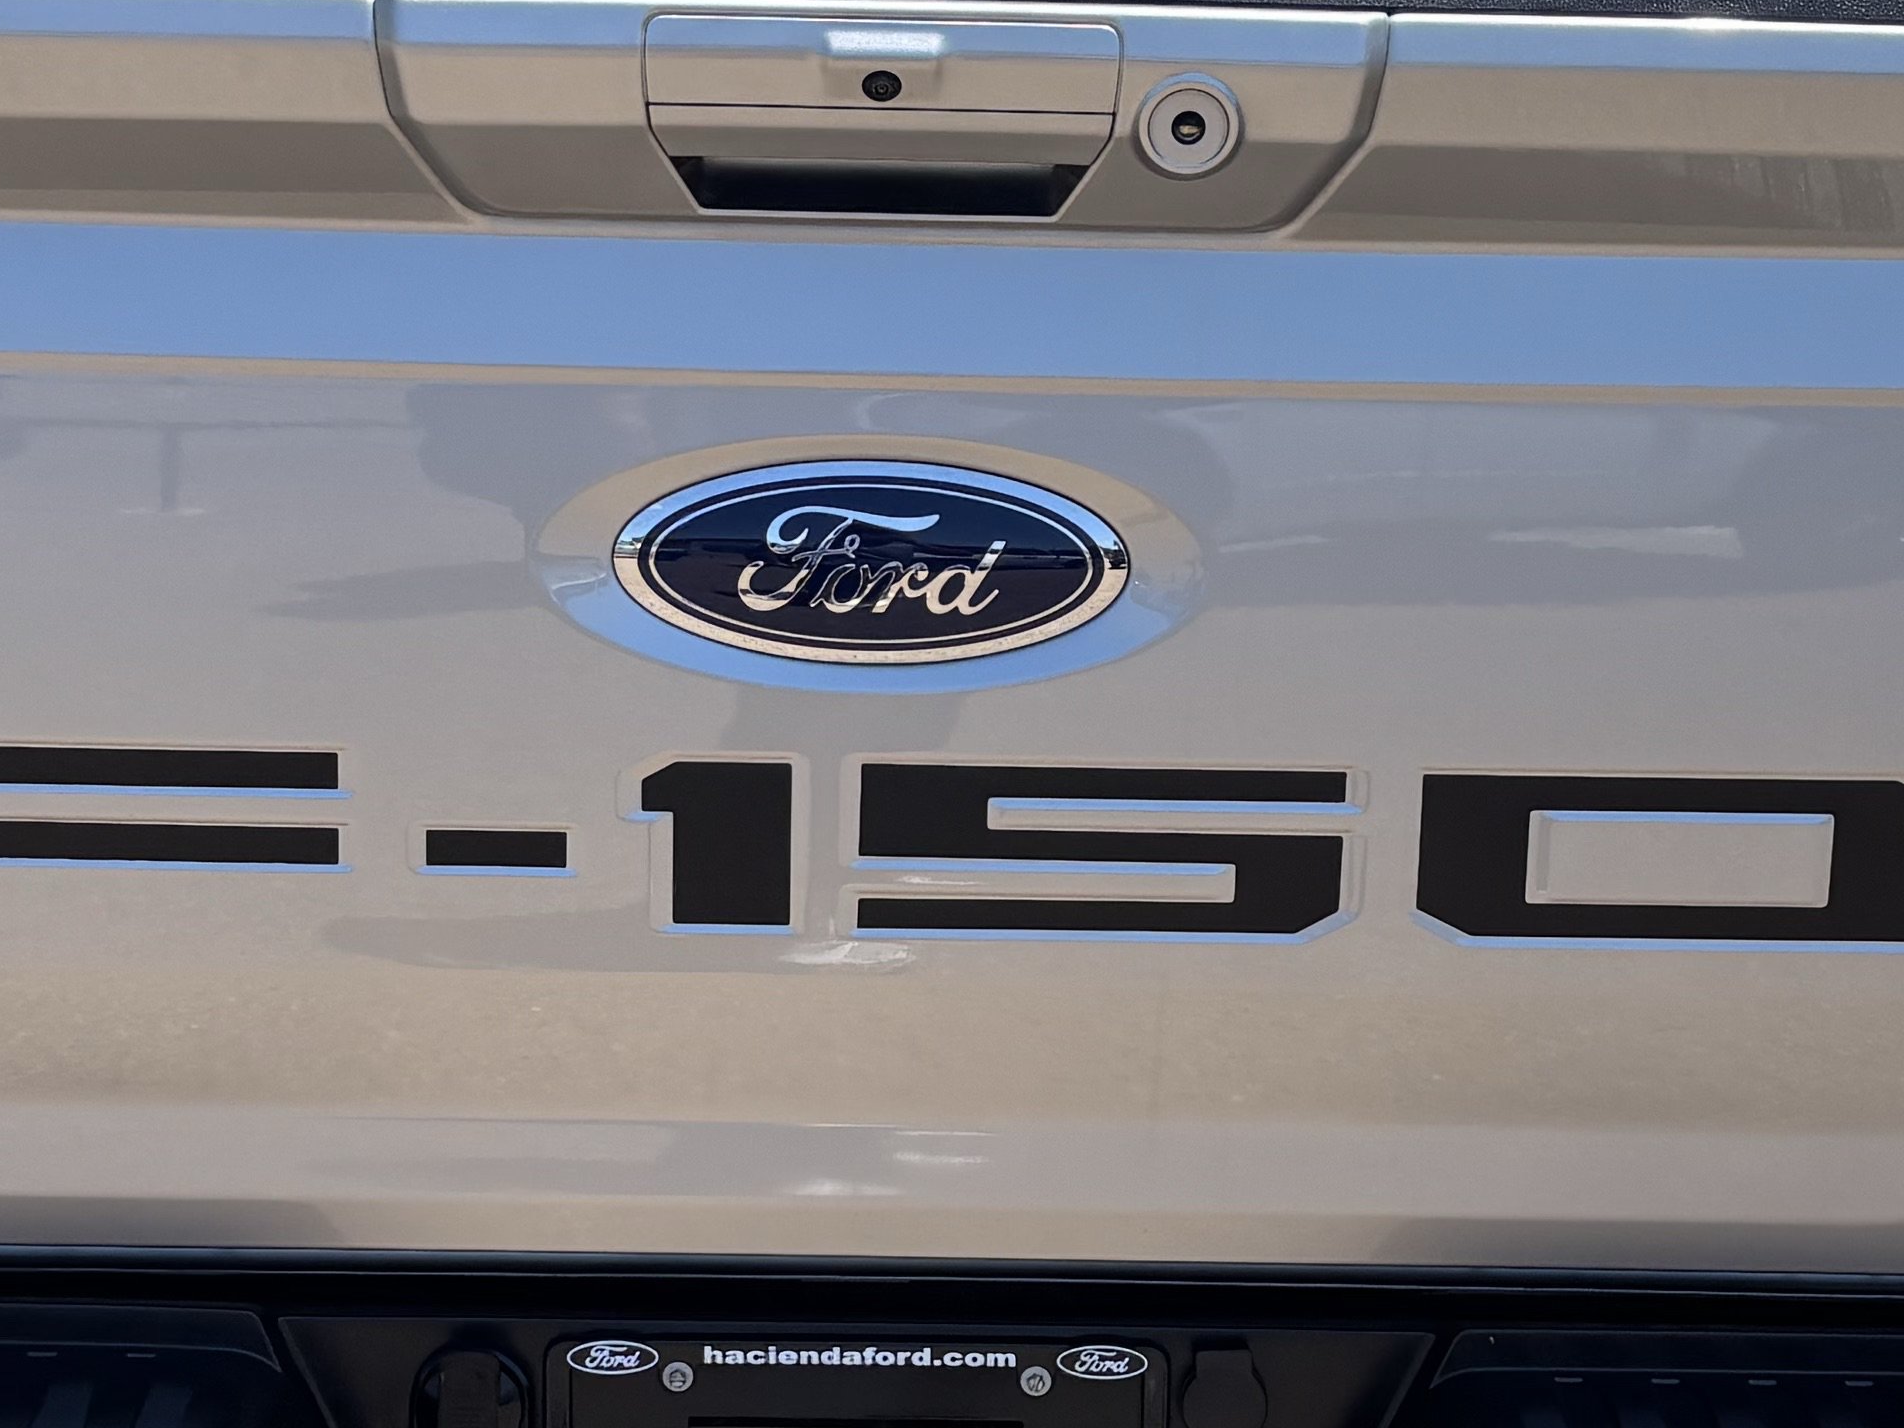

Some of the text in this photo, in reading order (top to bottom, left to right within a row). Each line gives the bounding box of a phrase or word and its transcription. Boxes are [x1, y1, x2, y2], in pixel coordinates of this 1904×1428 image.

[738, 505, 1006, 616] Ford
[584, 1340, 642, 1369] Ford
[702, 1345, 1018, 1369] haciendaford.com
[1073, 1347, 1131, 1375] Ford
